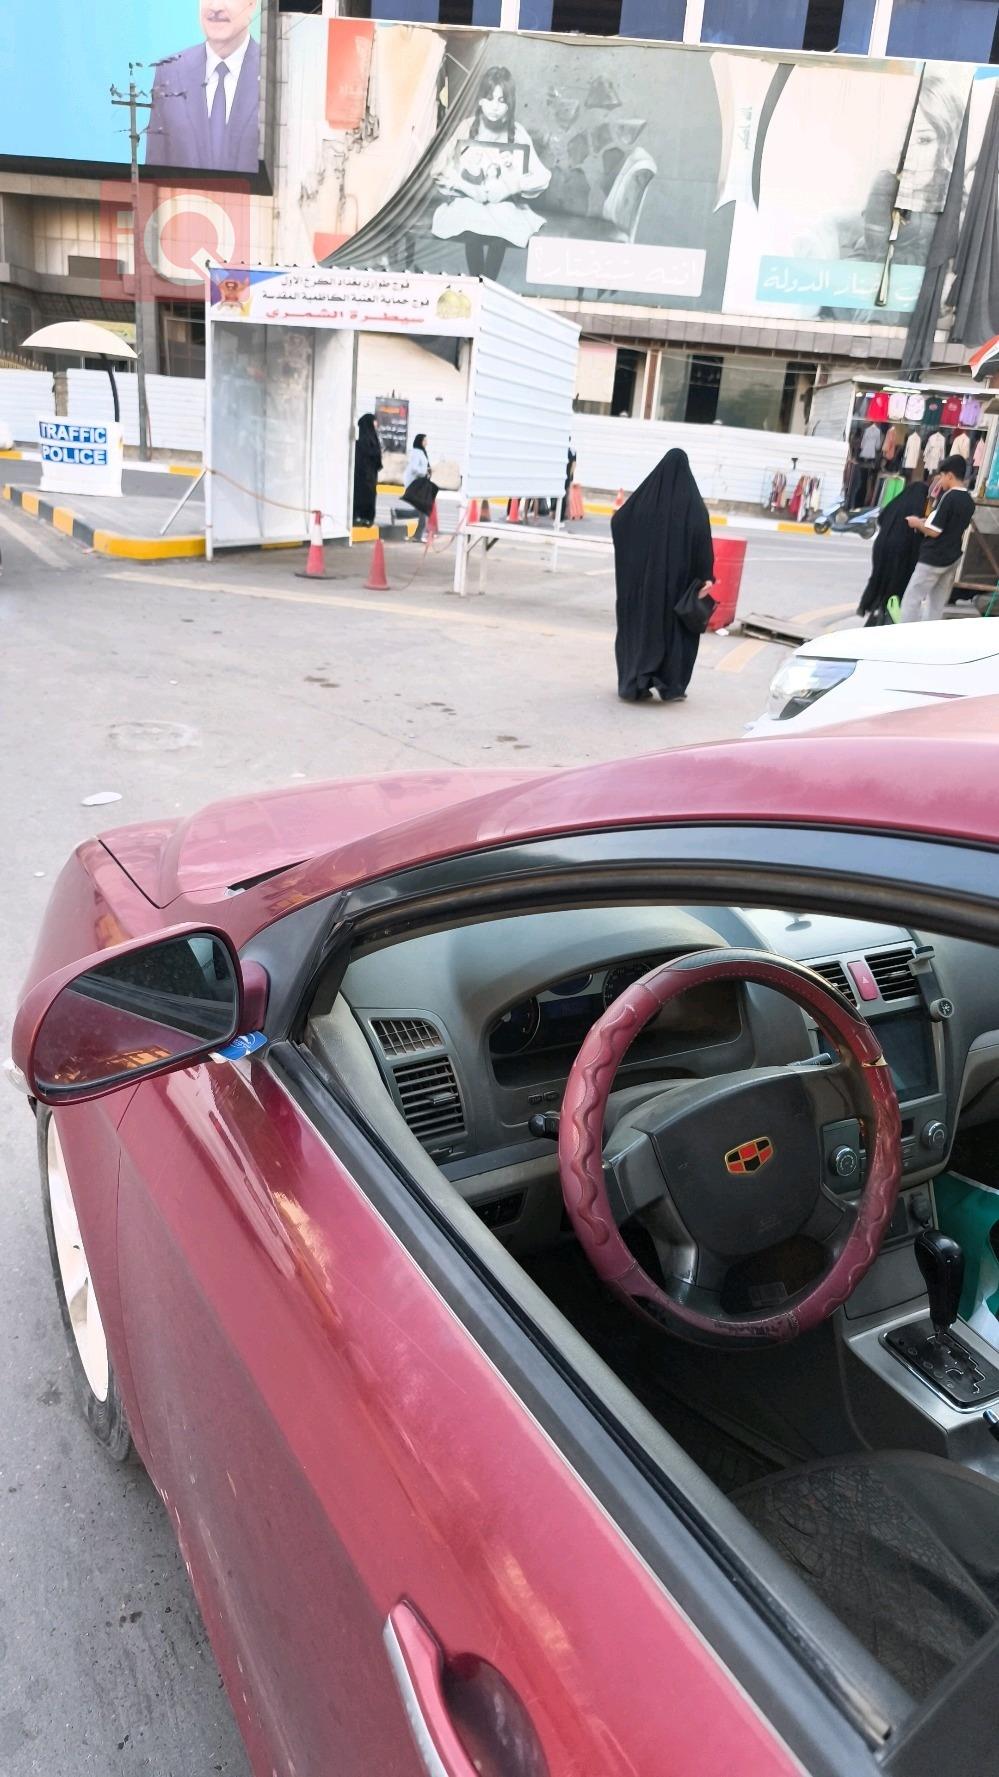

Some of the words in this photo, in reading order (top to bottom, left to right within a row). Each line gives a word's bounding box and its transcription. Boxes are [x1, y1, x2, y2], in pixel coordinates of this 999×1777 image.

[304, 277, 334, 289] الكرخ
[337, 277, 361, 288] بغداد
[391, 279, 410, 291] فوج
[763, 266, 830, 293] الدولة
[262, 289, 299, 301] المقدسة
[302, 291, 349, 303] الكاظمية
[380, 293, 409, 306] حماية
[411, 296, 430, 308] فوج
[350, 310, 425, 325] سيطرة
[40, 422, 107, 443] TRAFFIC
[42, 445, 107, 465] POLICE
